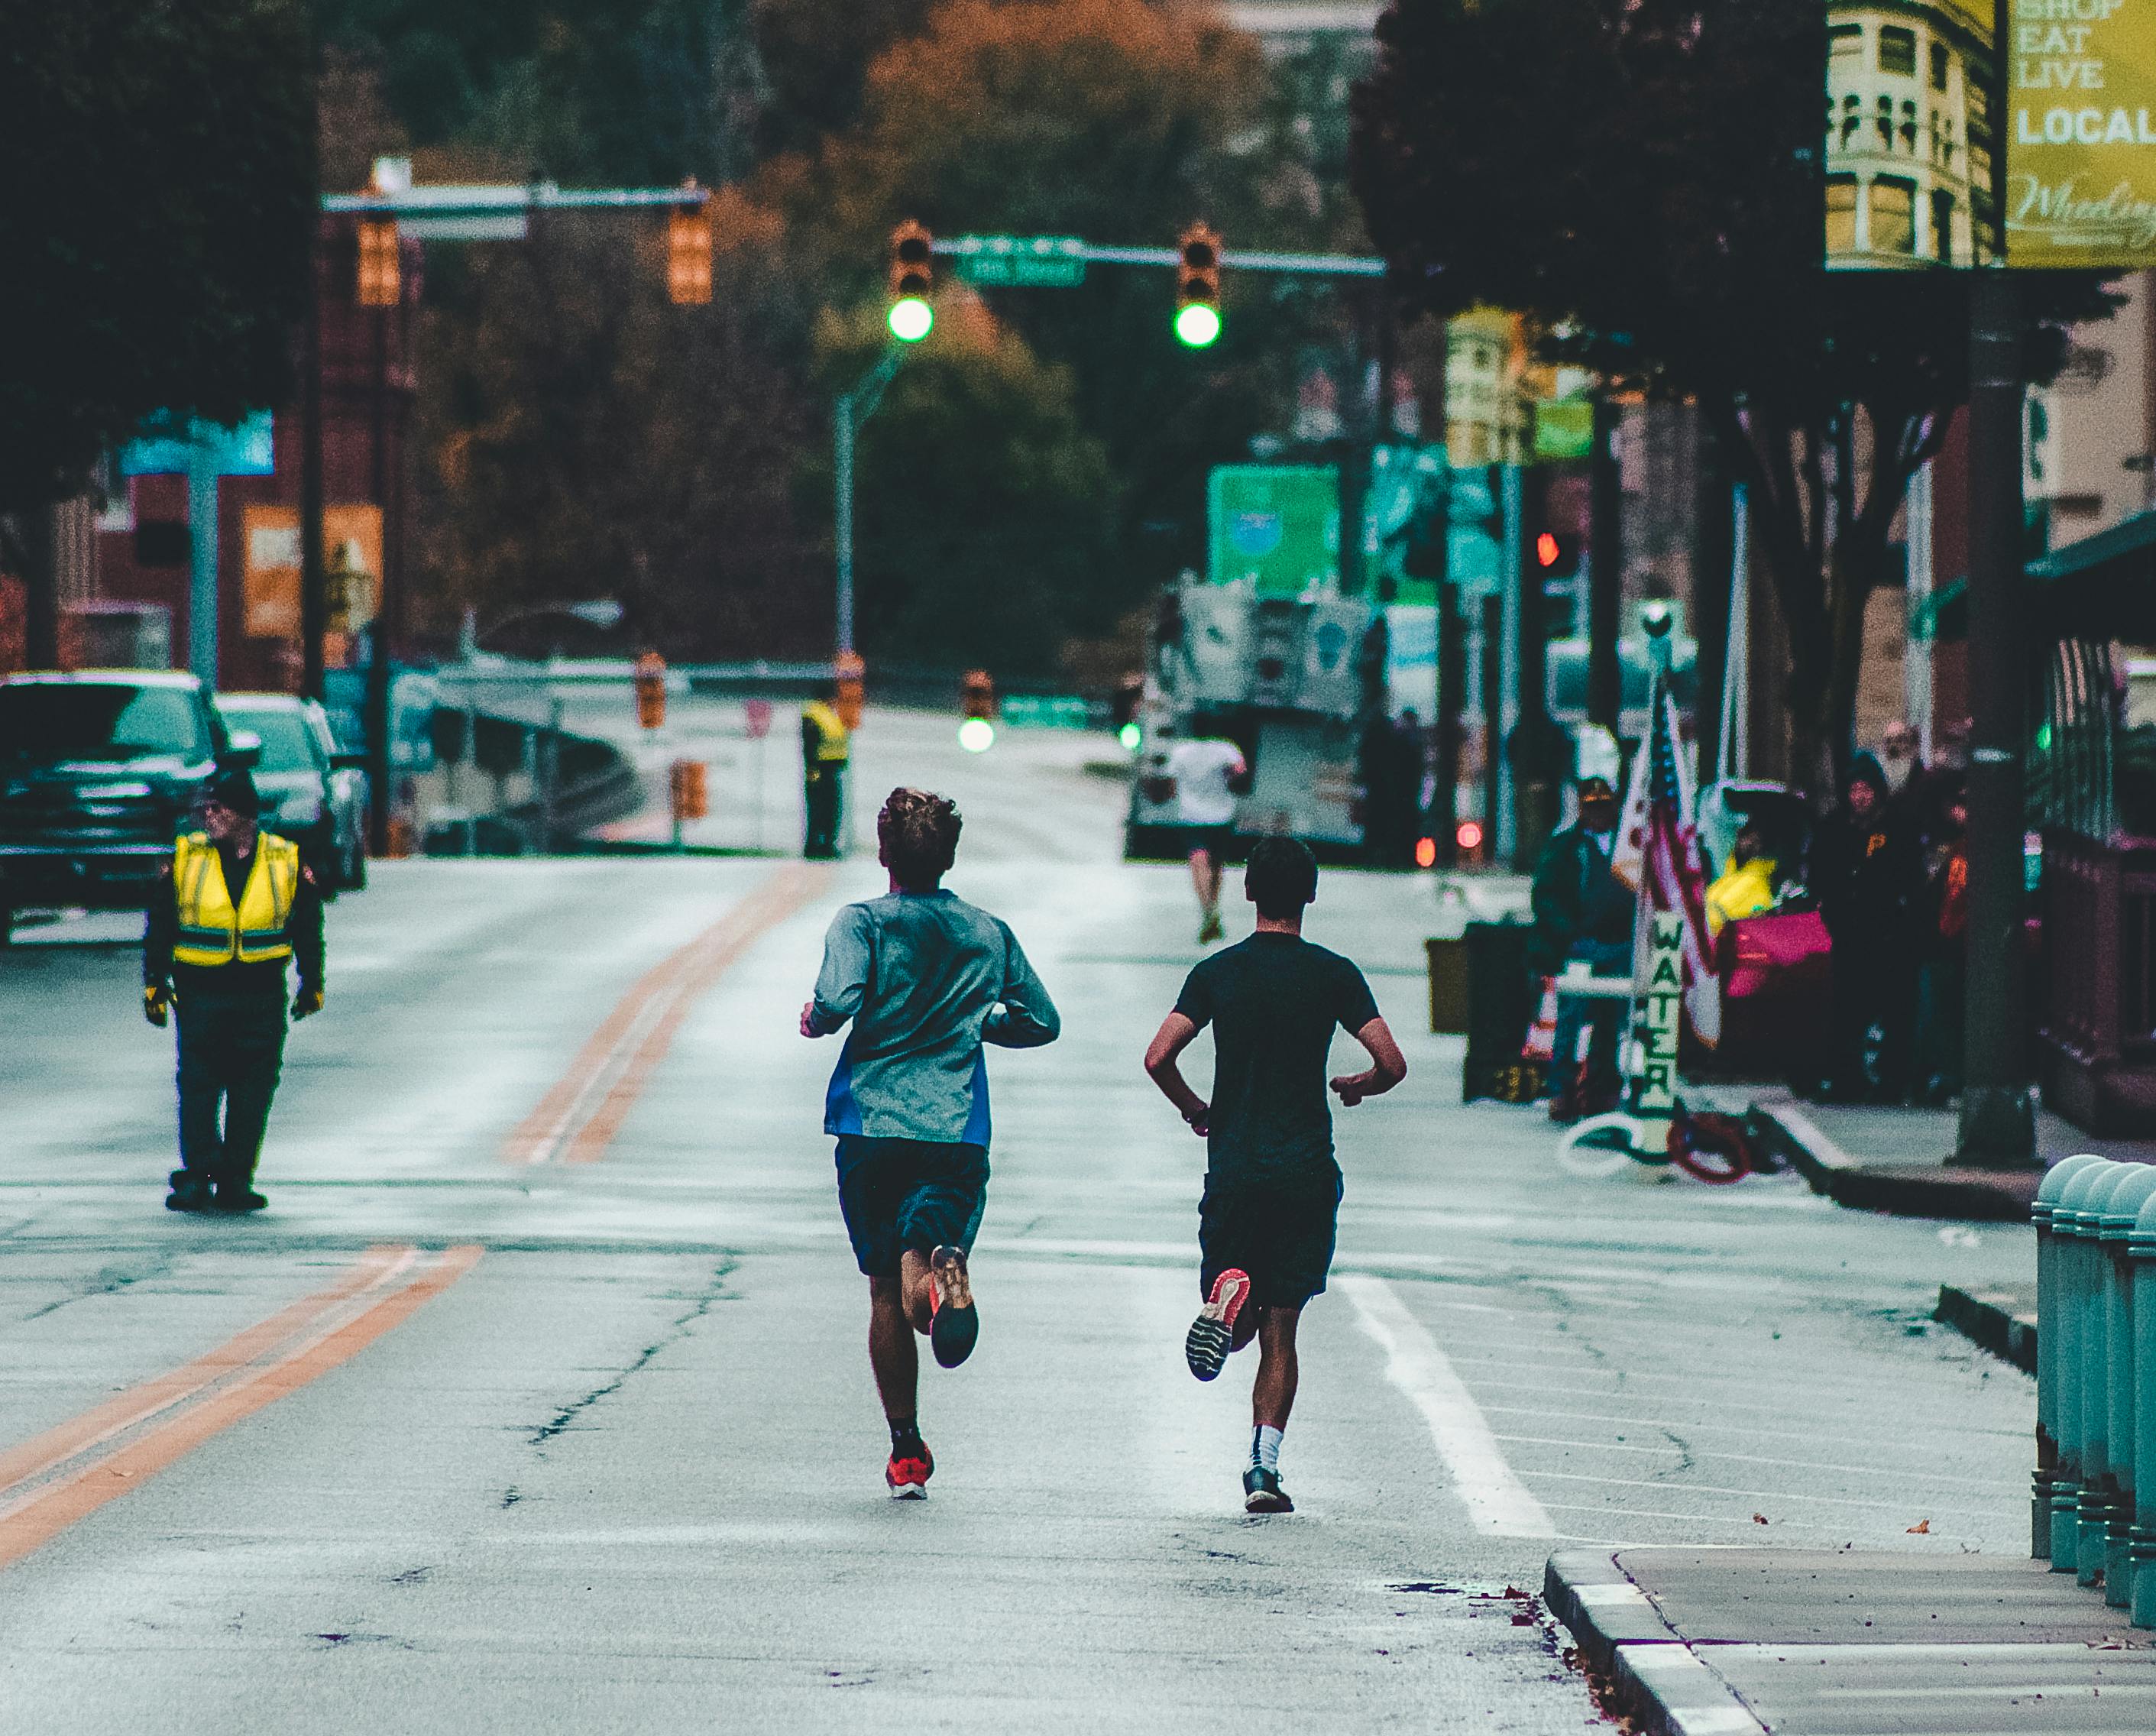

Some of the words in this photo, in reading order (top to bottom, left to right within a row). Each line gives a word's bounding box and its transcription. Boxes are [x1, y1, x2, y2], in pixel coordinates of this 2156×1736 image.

[2017, 24, 2092, 53] EAT
[2017, 59, 2104, 89] LIVE
[2017, 108, 2156, 144] LOCAL
[1644, 919, 1685, 1094] WATER
